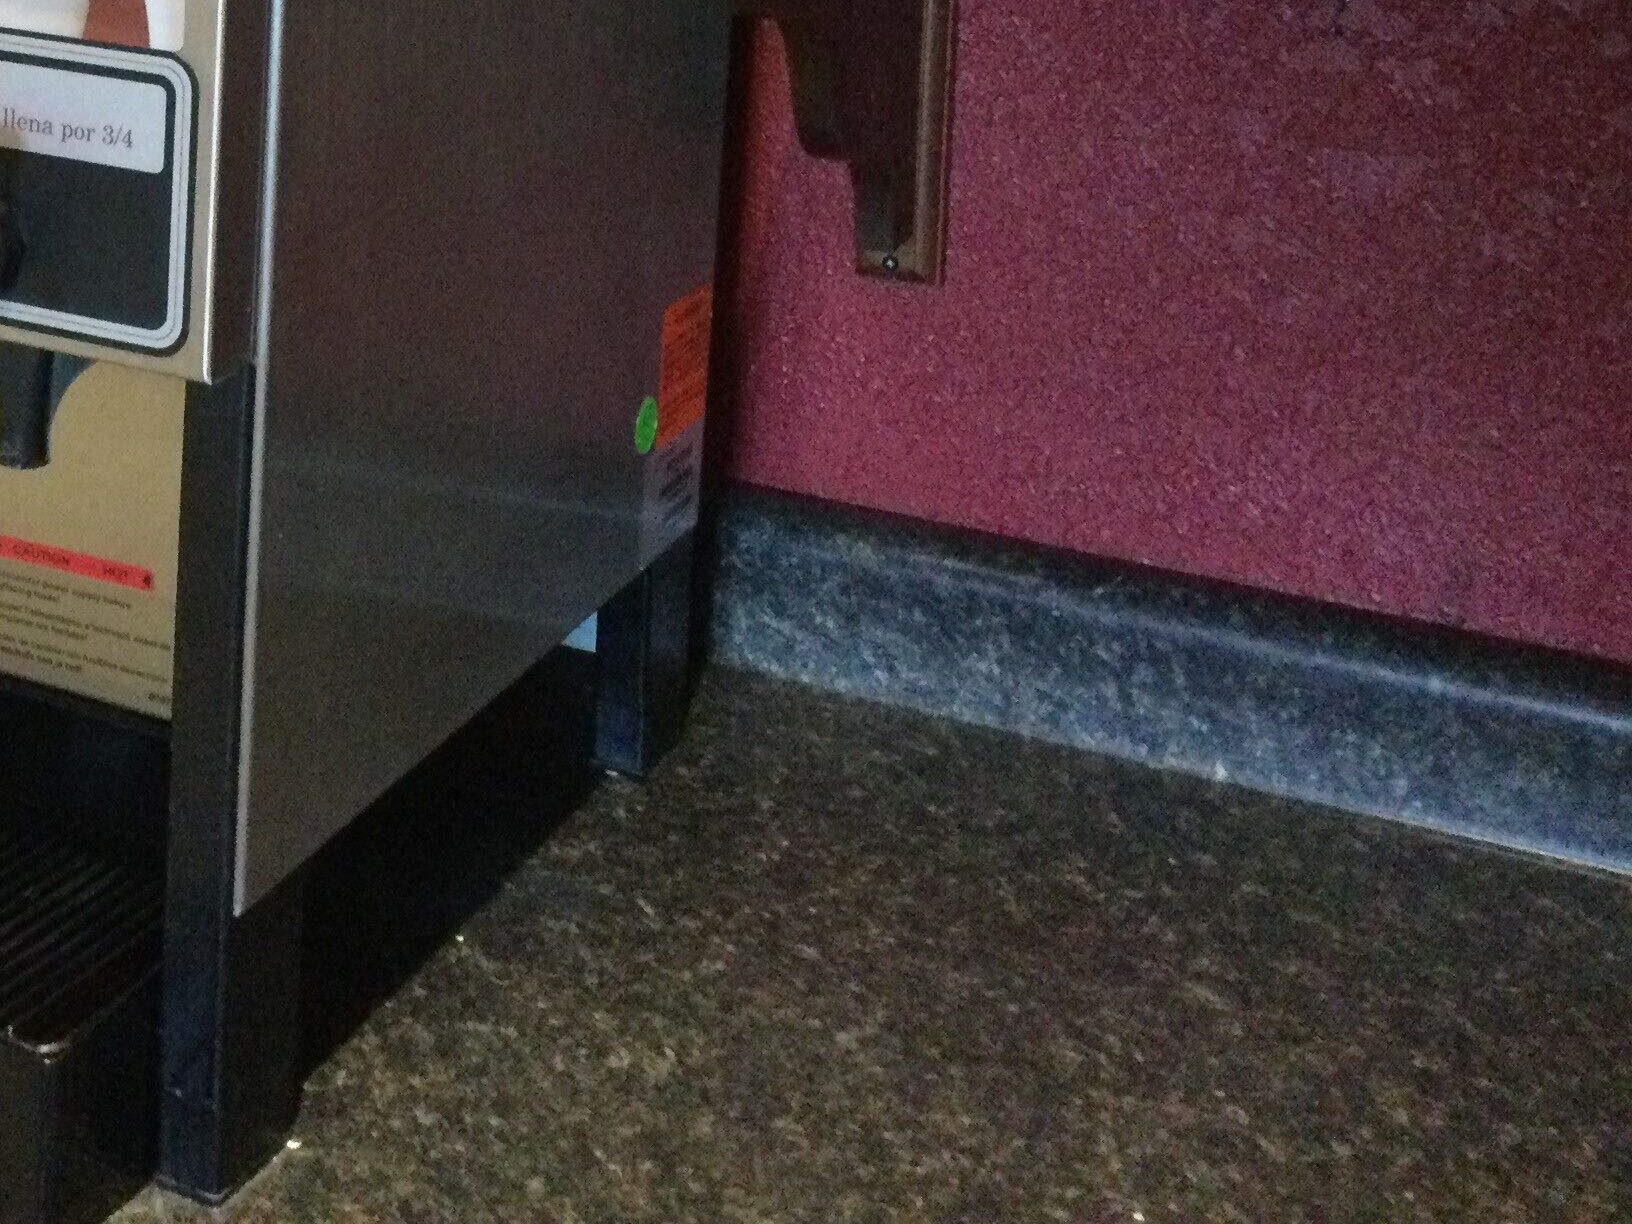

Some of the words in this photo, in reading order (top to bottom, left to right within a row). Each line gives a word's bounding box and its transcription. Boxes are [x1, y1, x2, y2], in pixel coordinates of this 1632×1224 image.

[3, 107, 53, 135] llena
[61, 123, 96, 143] por
[102, 124, 134, 148] 3/4
